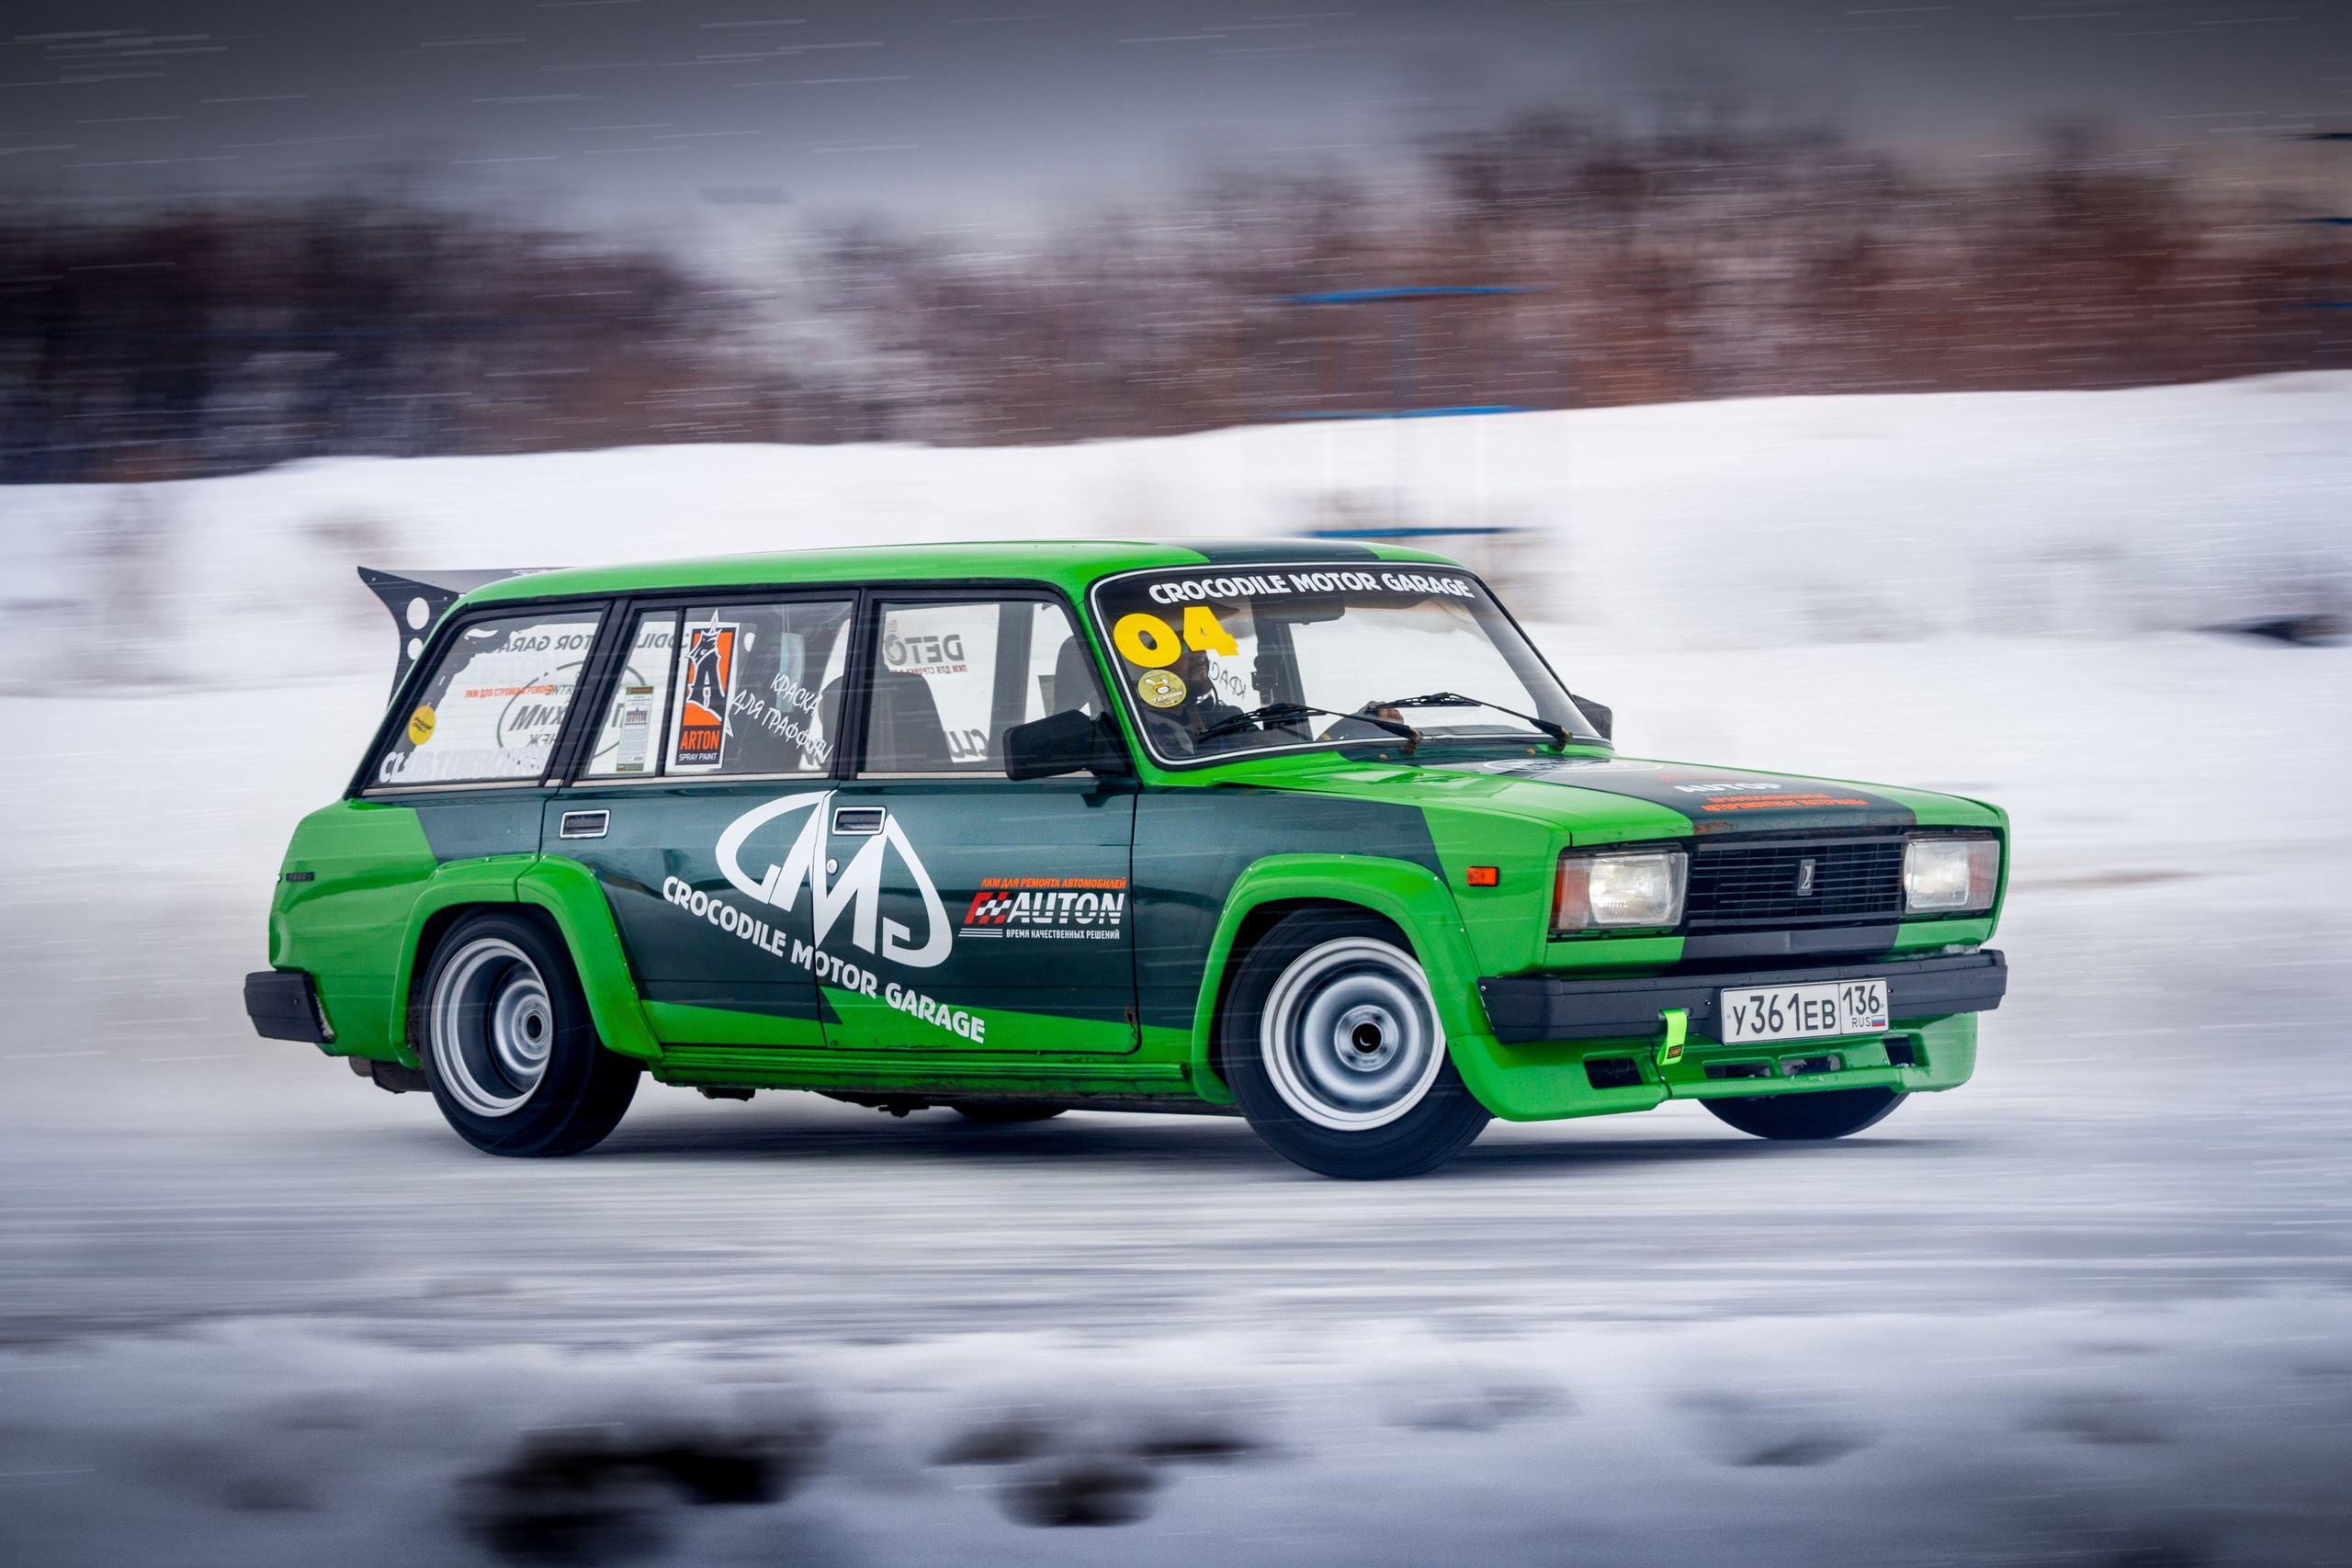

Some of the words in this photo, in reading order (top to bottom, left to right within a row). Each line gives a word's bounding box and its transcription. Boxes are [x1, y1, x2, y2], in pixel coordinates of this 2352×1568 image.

[1149, 574, 1292, 604] CROCODILE
[1288, 571, 1382, 592] MOTOR
[1381, 573, 1476, 599] GARAGE
[1113, 605, 1239, 669] 04
[731, 689, 765, 719] ДЛЯ
[770, 672, 820, 716] КРАСКА
[680, 730, 720, 750] ARTON
[679, 753, 698, 761] SPRAY
[699, 752, 718, 761] PAINT
[981, 878, 1001, 888] ЛКМ
[1001, 878, 1018, 889] ДЛЯ
[1020, 878, 1060, 888] РЕМОНТА
[1061, 877, 1126, 889] АВТОМОБИЛЕЙ
[1006, 892, 1125, 925] AUTON
[1006, 929, 1030, 939] ВРЕМЯ
[1031, 930, 1085, 940] КАЧЕСТВЕННЫХ
[1086, 929, 1120, 940] РЕШЕНИЙ
[662, 875, 786, 957] CROCODILE
[790, 938, 876, 999] MOTOR
[885, 982, 986, 1044] GARAGE
[1842, 985, 1880, 1016] 136
[1851, 1016, 1871, 1028] RUS
